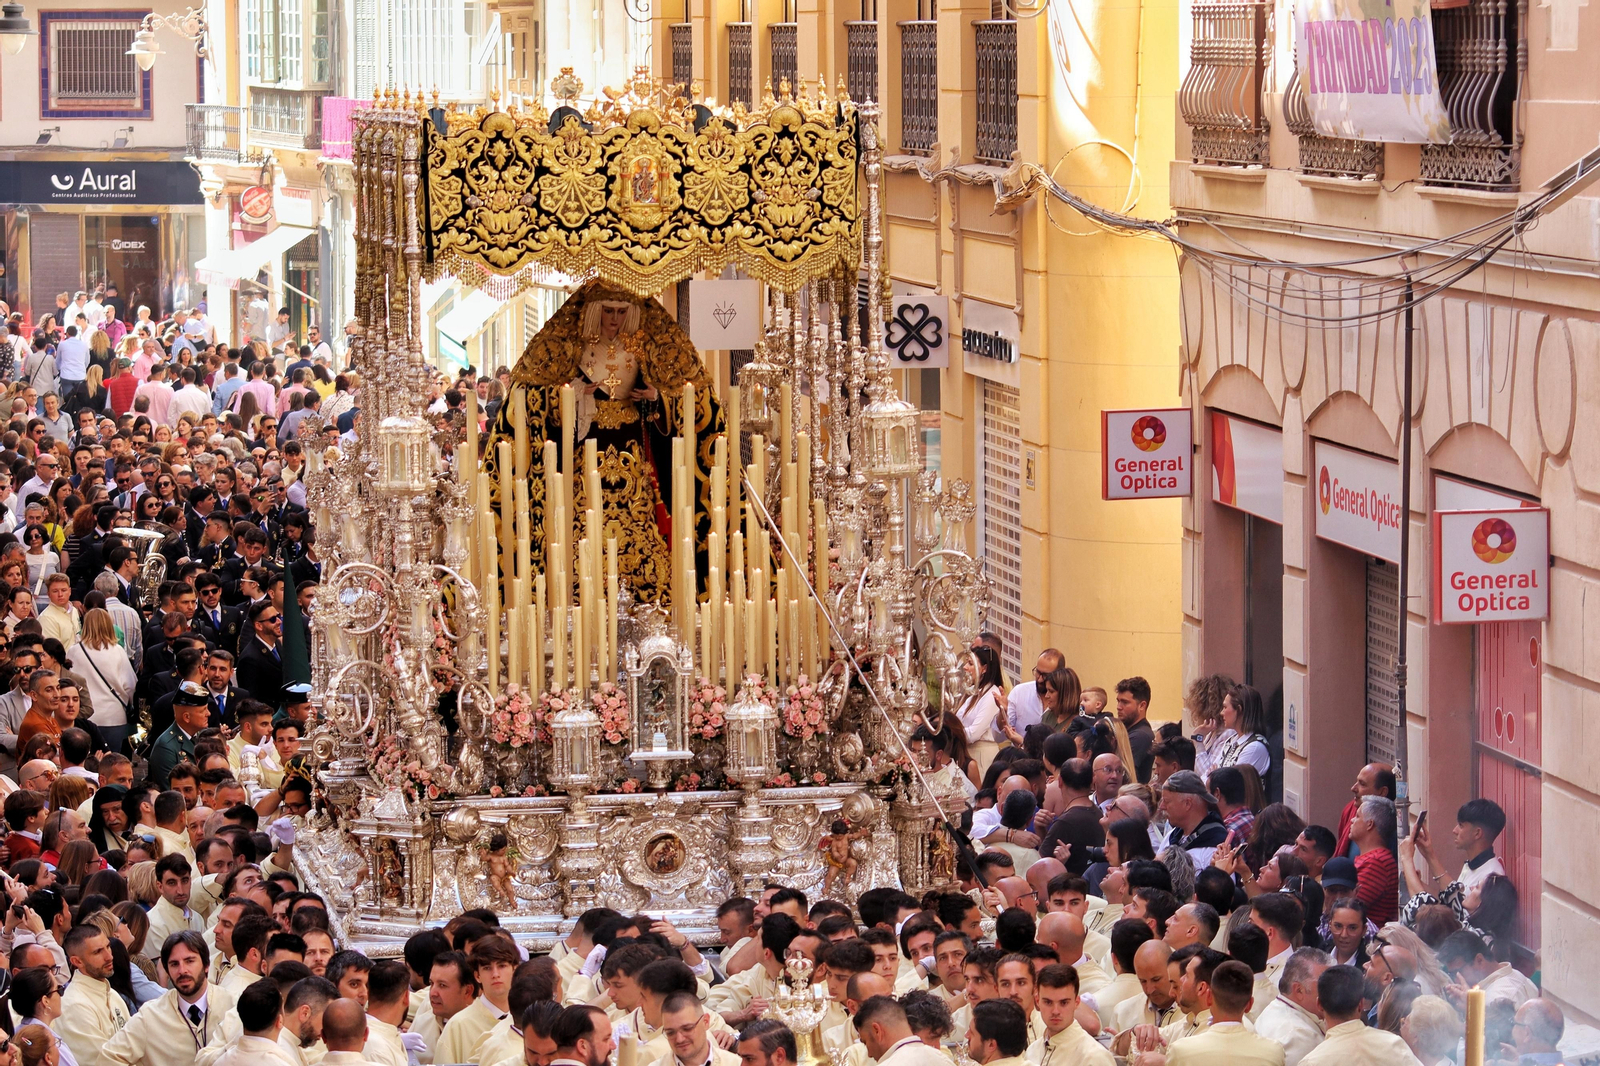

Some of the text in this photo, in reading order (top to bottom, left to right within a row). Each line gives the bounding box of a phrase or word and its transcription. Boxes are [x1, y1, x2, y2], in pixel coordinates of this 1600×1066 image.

[79, 167, 136, 191] Aural
[112, 239, 145, 250] WIDEX
[1114, 455, 1184, 473] General
[1120, 473, 1177, 493] Optica
[1333, 477, 1368, 519] General
[1450, 569, 1538, 590] General
[1458, 591, 1530, 616] Optica
